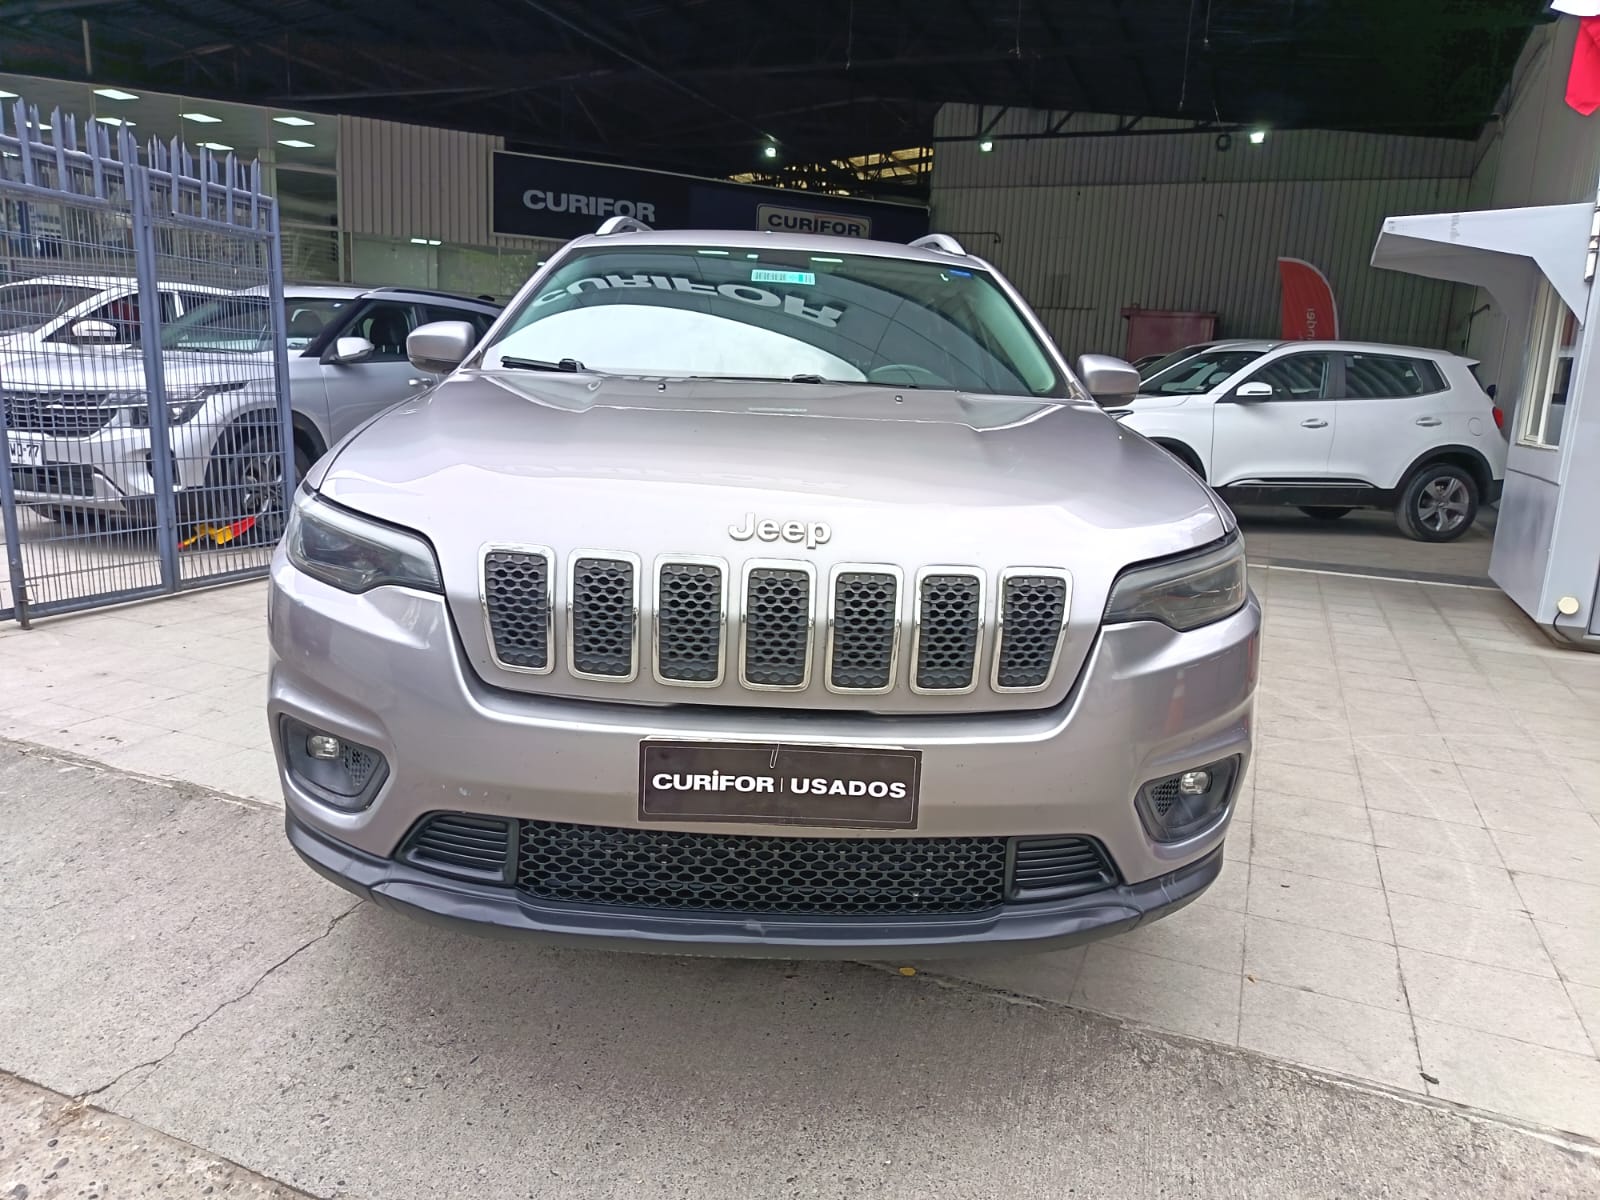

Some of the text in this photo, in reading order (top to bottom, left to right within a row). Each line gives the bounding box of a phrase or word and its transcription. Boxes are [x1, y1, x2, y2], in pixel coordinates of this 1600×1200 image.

[523, 189, 656, 223] CURIFOR
[727, 511, 832, 550] Jeep
[790, 778, 906, 799] USADOS
